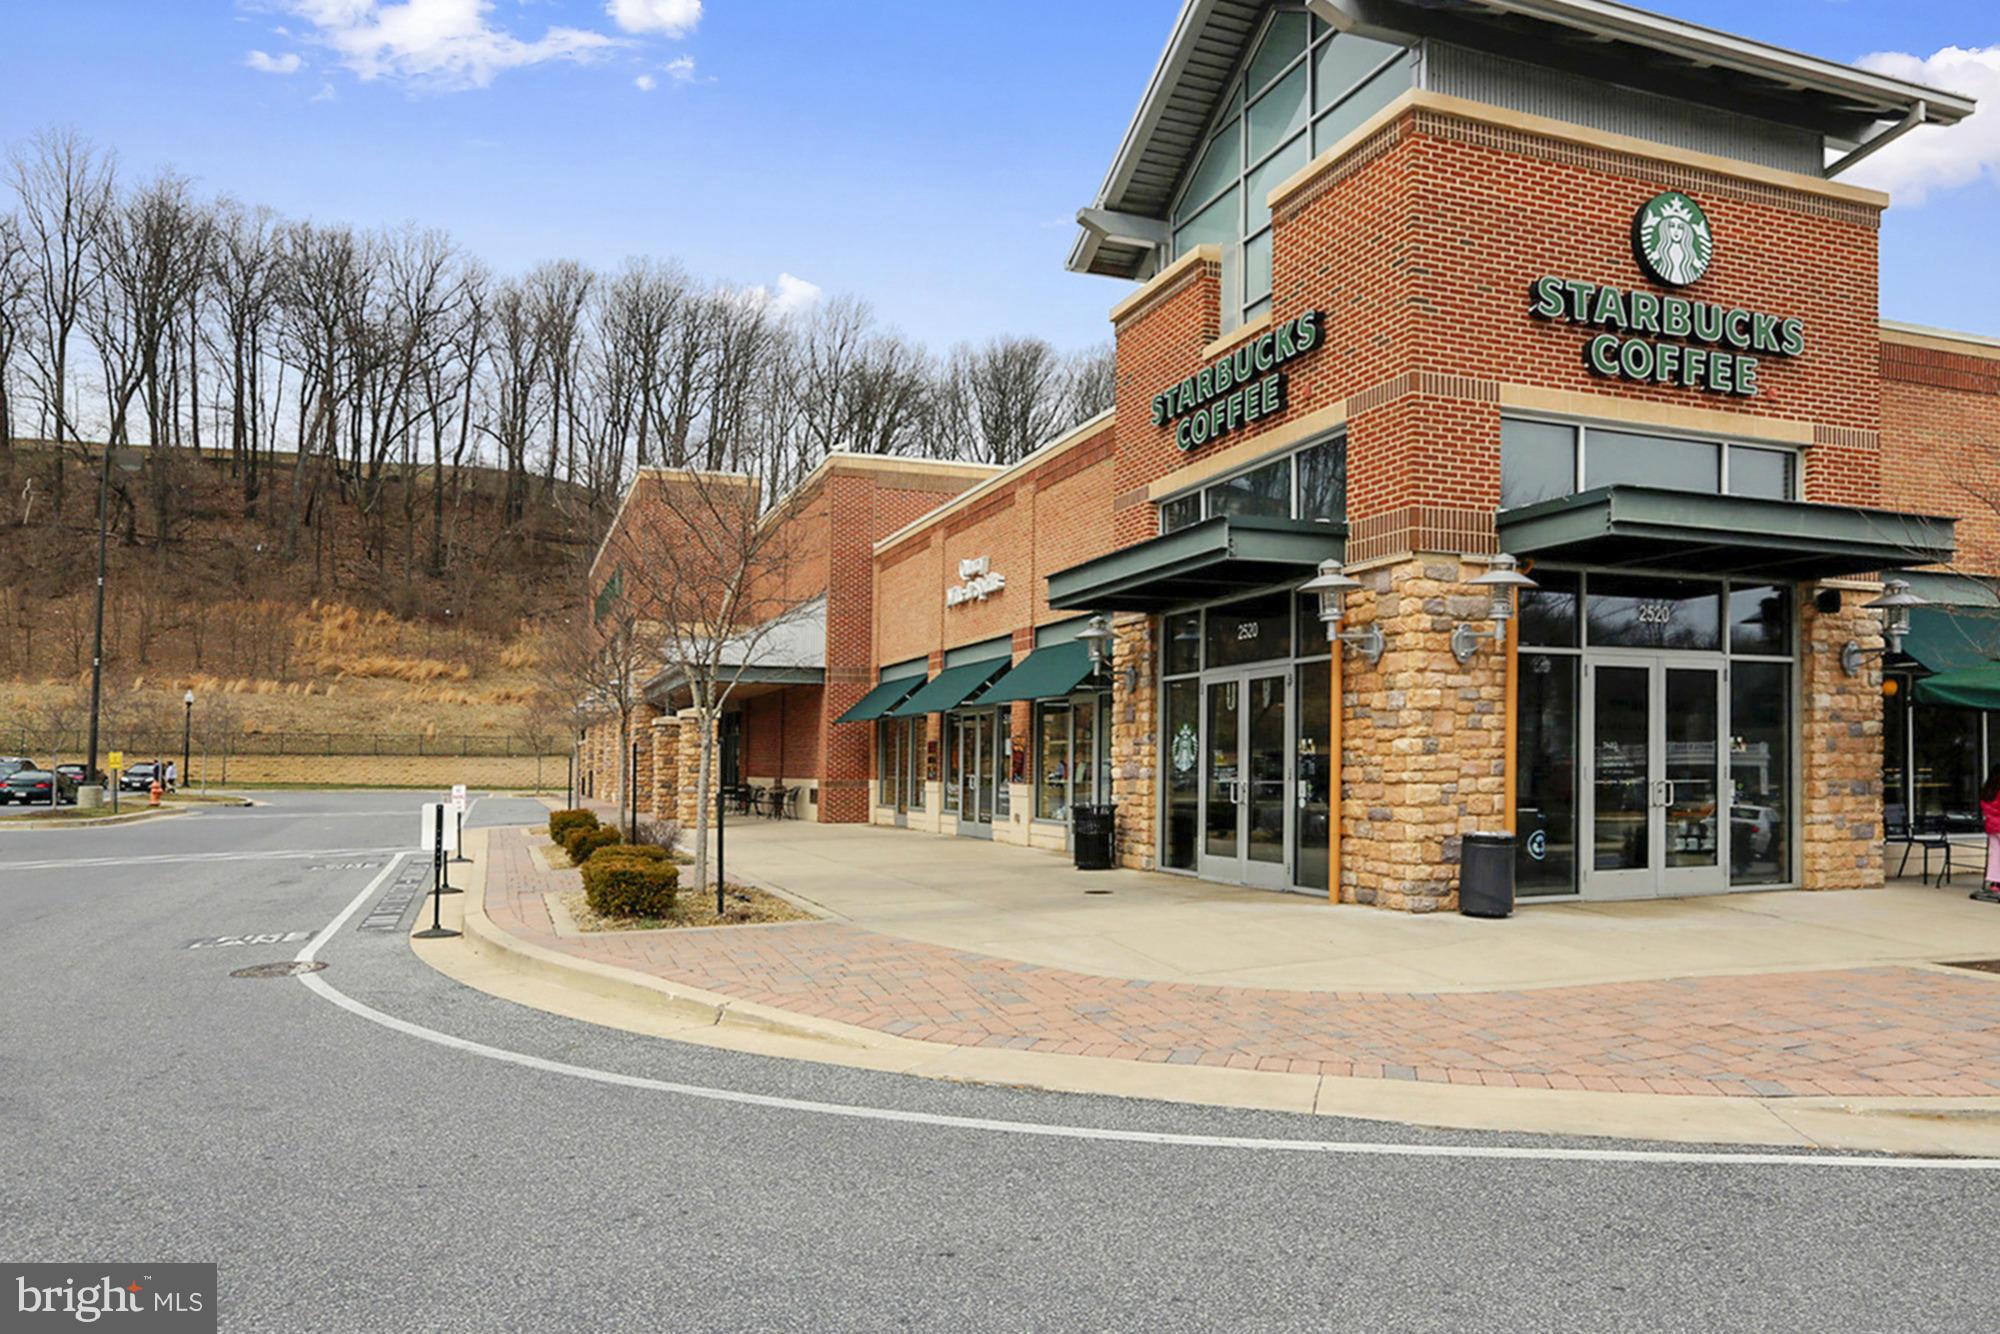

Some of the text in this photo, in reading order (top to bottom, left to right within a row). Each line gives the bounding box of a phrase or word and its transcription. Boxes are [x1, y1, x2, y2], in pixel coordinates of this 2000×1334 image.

[1537, 275, 1805, 356] STARBUCKS
[1151, 309, 1318, 426] STARBUCKS
[1591, 334, 1759, 396] COFFEE
[1175, 373, 1280, 450] COFFEE
[1237, 621, 1259, 640] 2520
[1639, 604, 1670, 622] 2520
